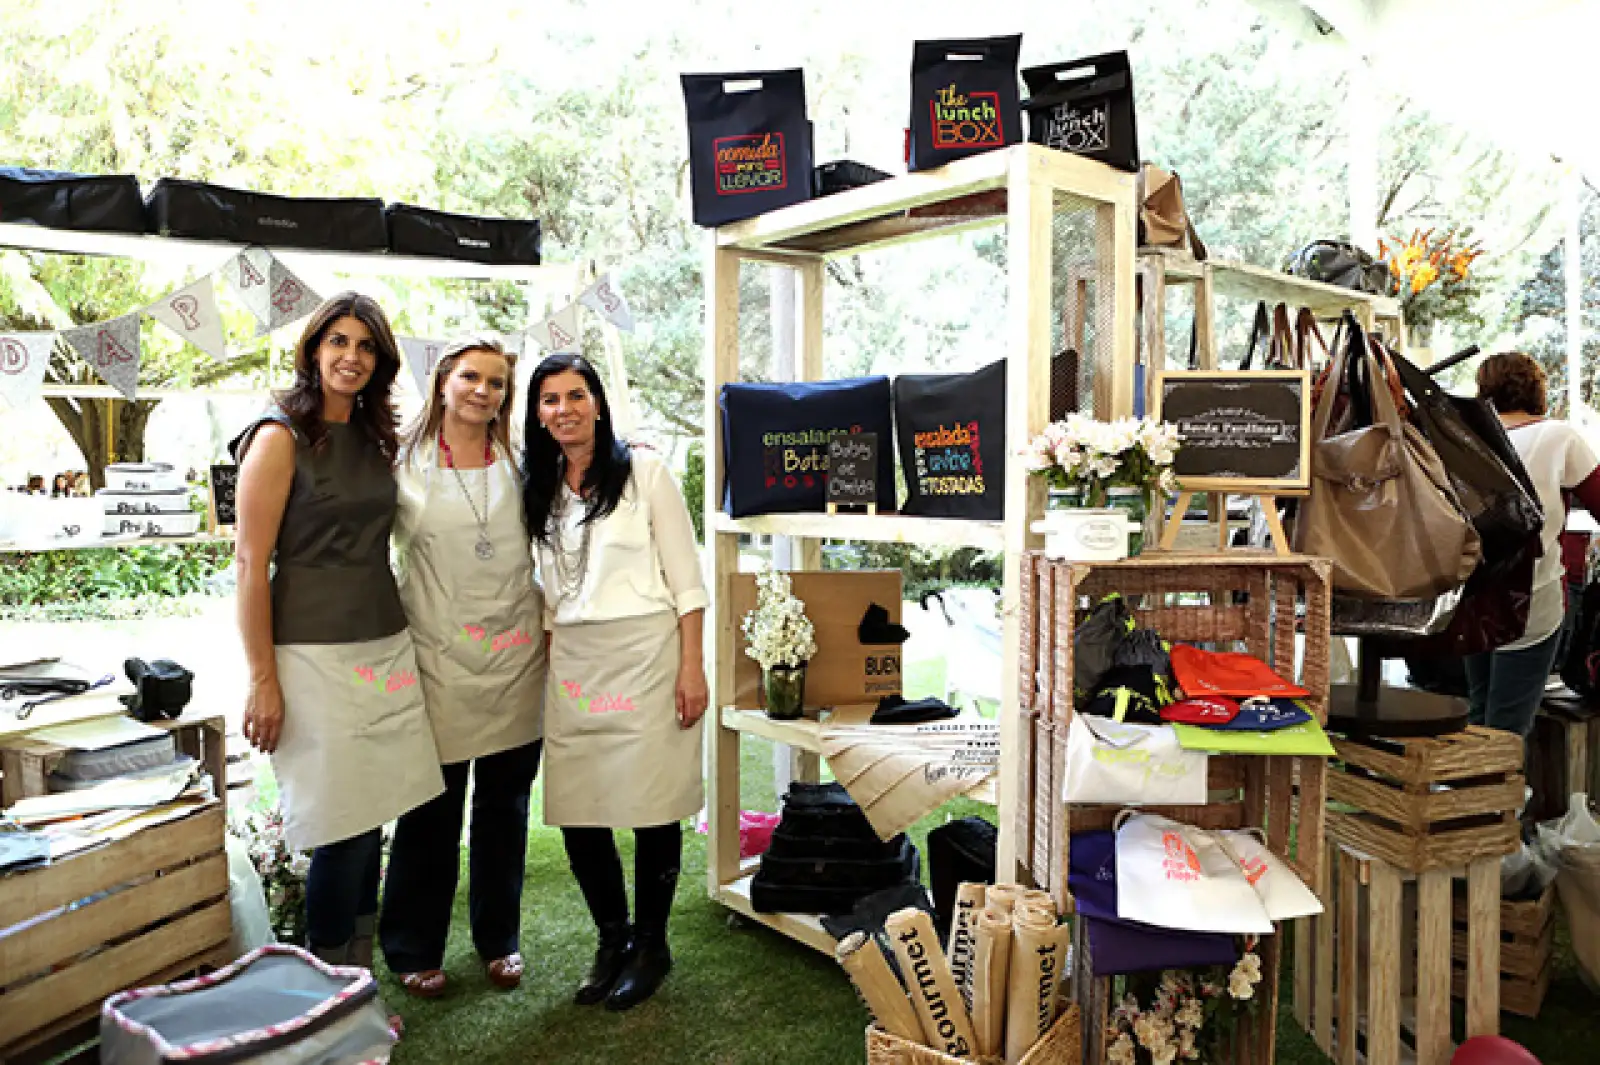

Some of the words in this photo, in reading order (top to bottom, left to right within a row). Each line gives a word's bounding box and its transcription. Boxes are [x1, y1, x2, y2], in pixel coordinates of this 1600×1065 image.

[934, 101, 996, 121] lunch
[937, 119, 1000, 144] BOX
[783, 447, 830, 473] Bota
[951, 899, 976, 986] urmet
